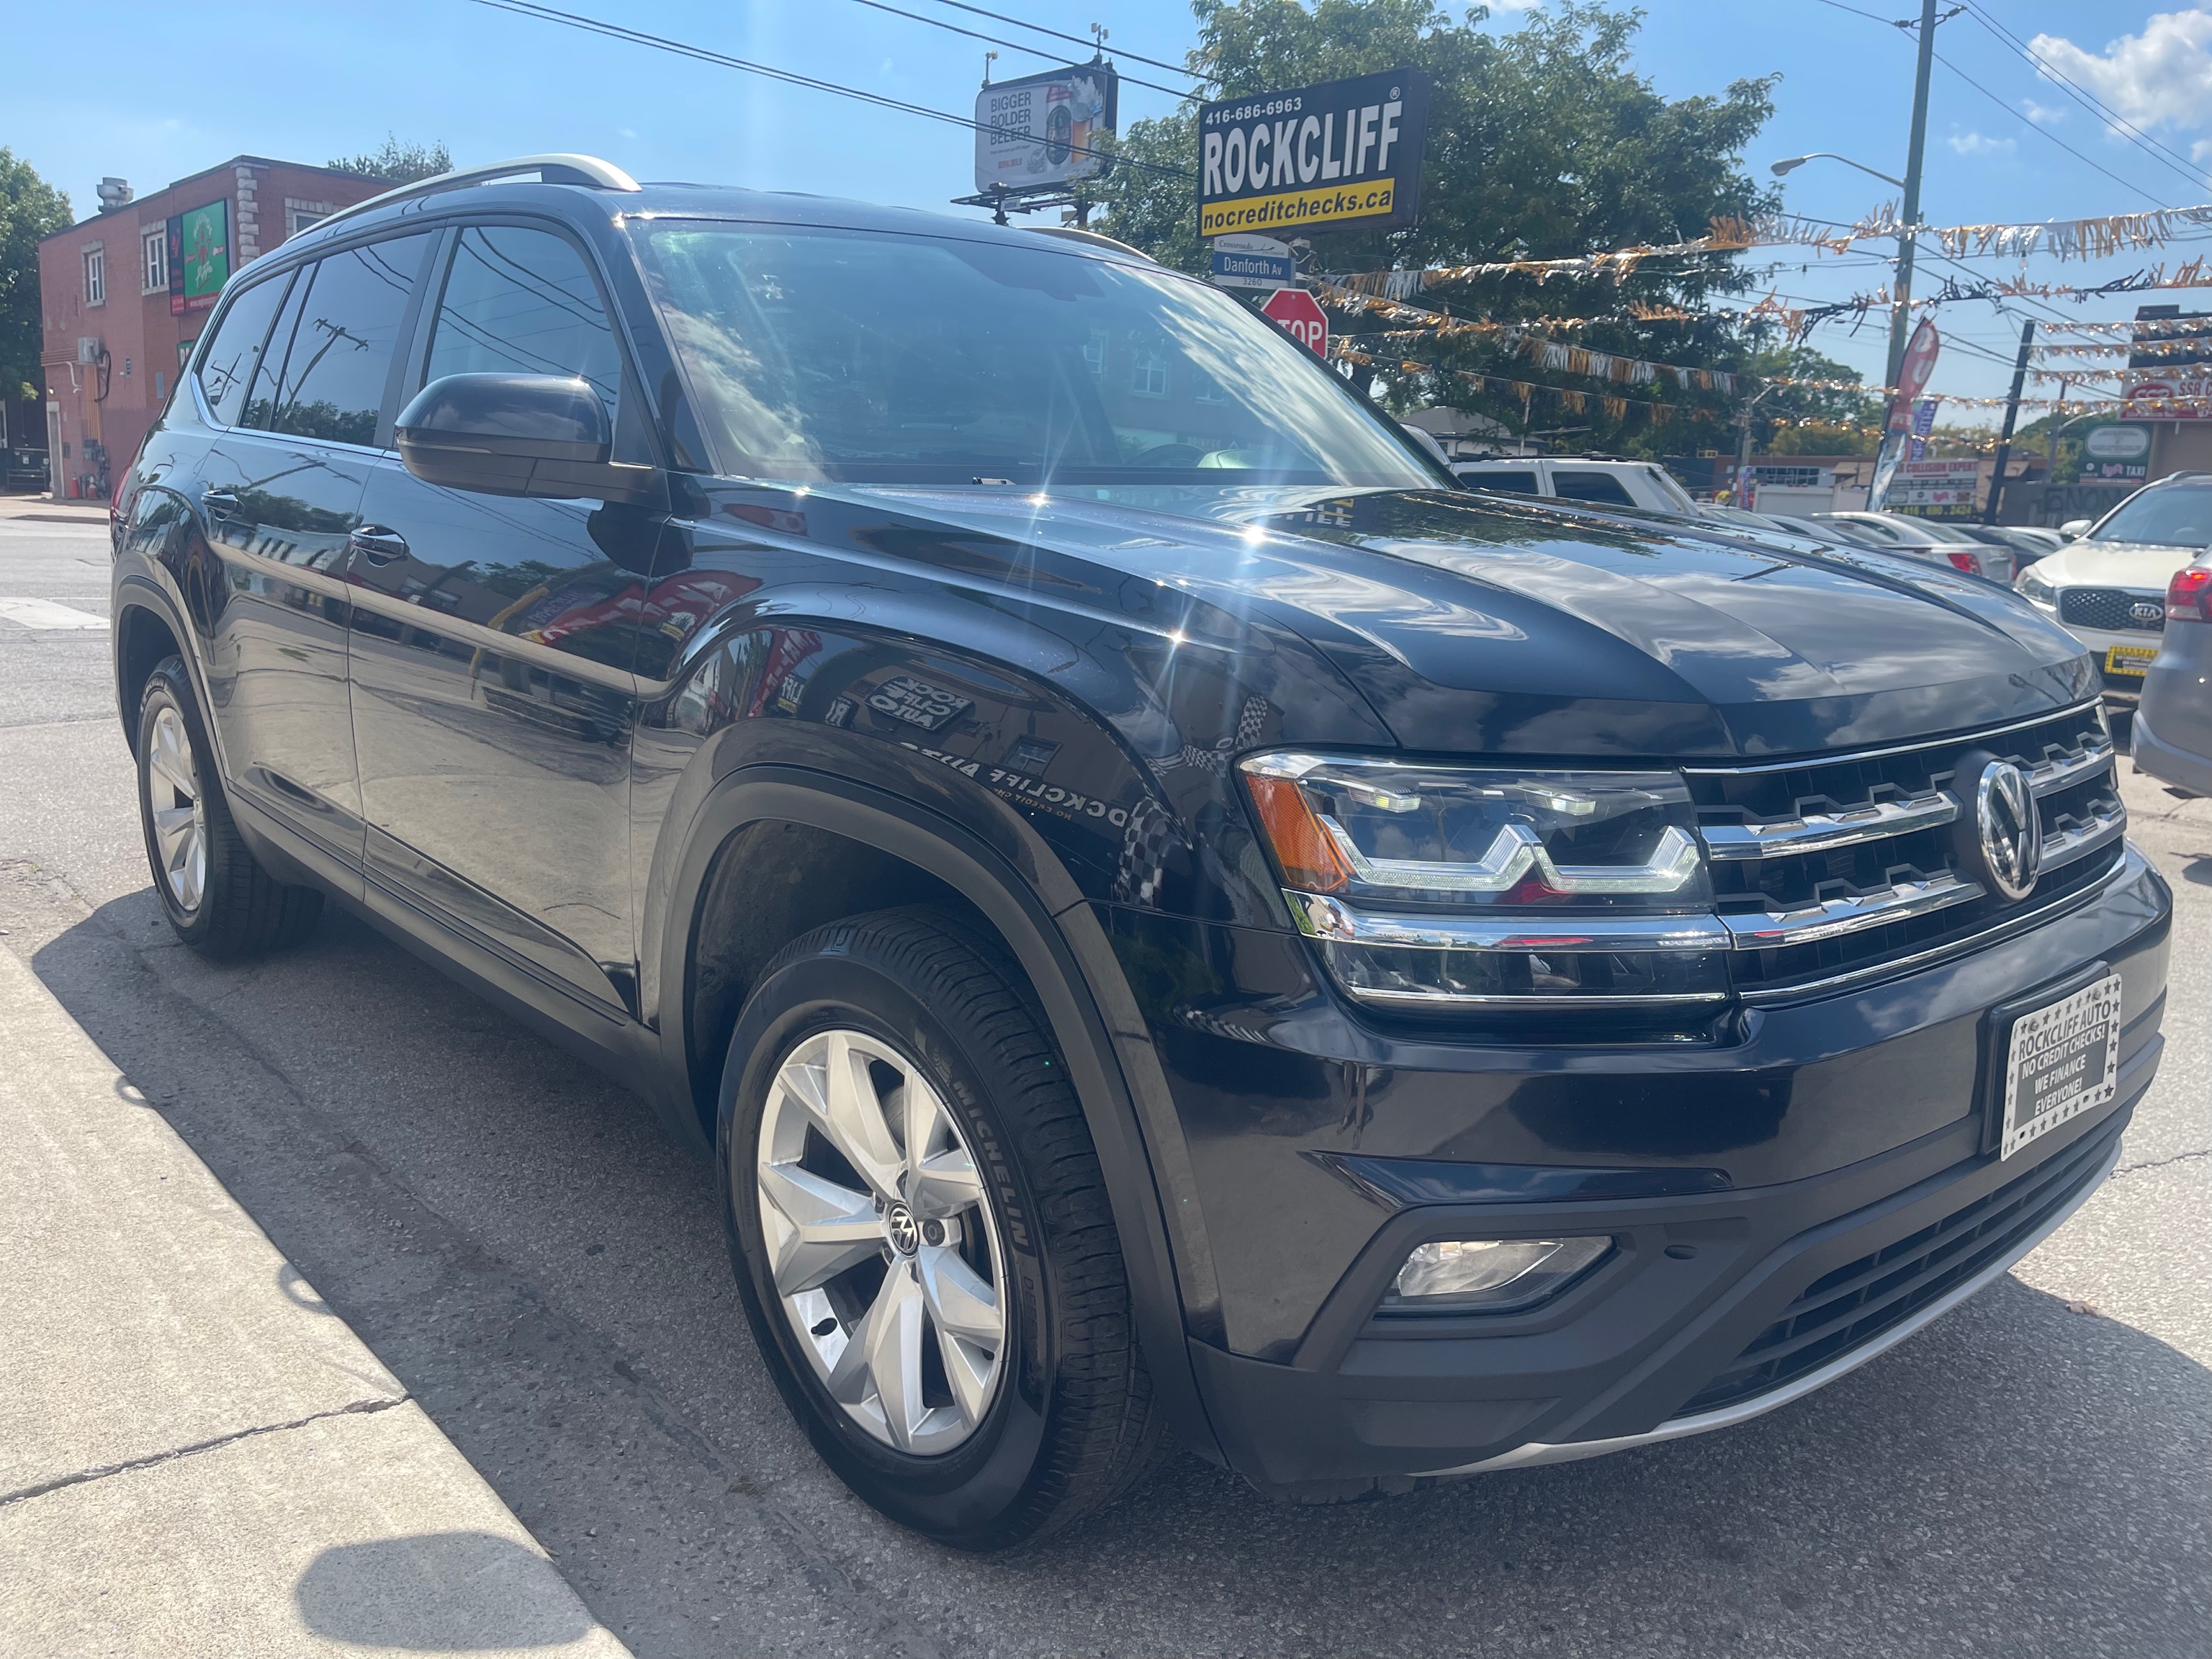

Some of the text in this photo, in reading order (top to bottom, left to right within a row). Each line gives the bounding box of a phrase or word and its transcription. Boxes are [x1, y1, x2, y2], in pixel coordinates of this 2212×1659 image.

[991, 91, 1031, 112] BIGGER
[991, 109, 1031, 128] BOLDER
[1205, 96, 1303, 125] 416-686-6963
[1203, 100, 1403, 196] ROCKCLIFF
[1203, 189, 1391, 229] nocreditchecks.ca
[1219, 240, 1253, 250] Crossroads
[1224, 256, 1282, 275] Danforth Av
[1243, 277, 1262, 286] 3260
[2134, 607, 2157, 618] KIA
[2020, 1000, 2111, 1061] ROCKCLIFF AUTO
[2022, 1023, 2105, 1079] NO CREDIT CHECKS!
[2034, 1053, 2087, 1094] WE FINANCE
[2034, 1077, 2083, 1117] EVERYONE!
[953, 1081, 1030, 1247] MICHELIN
